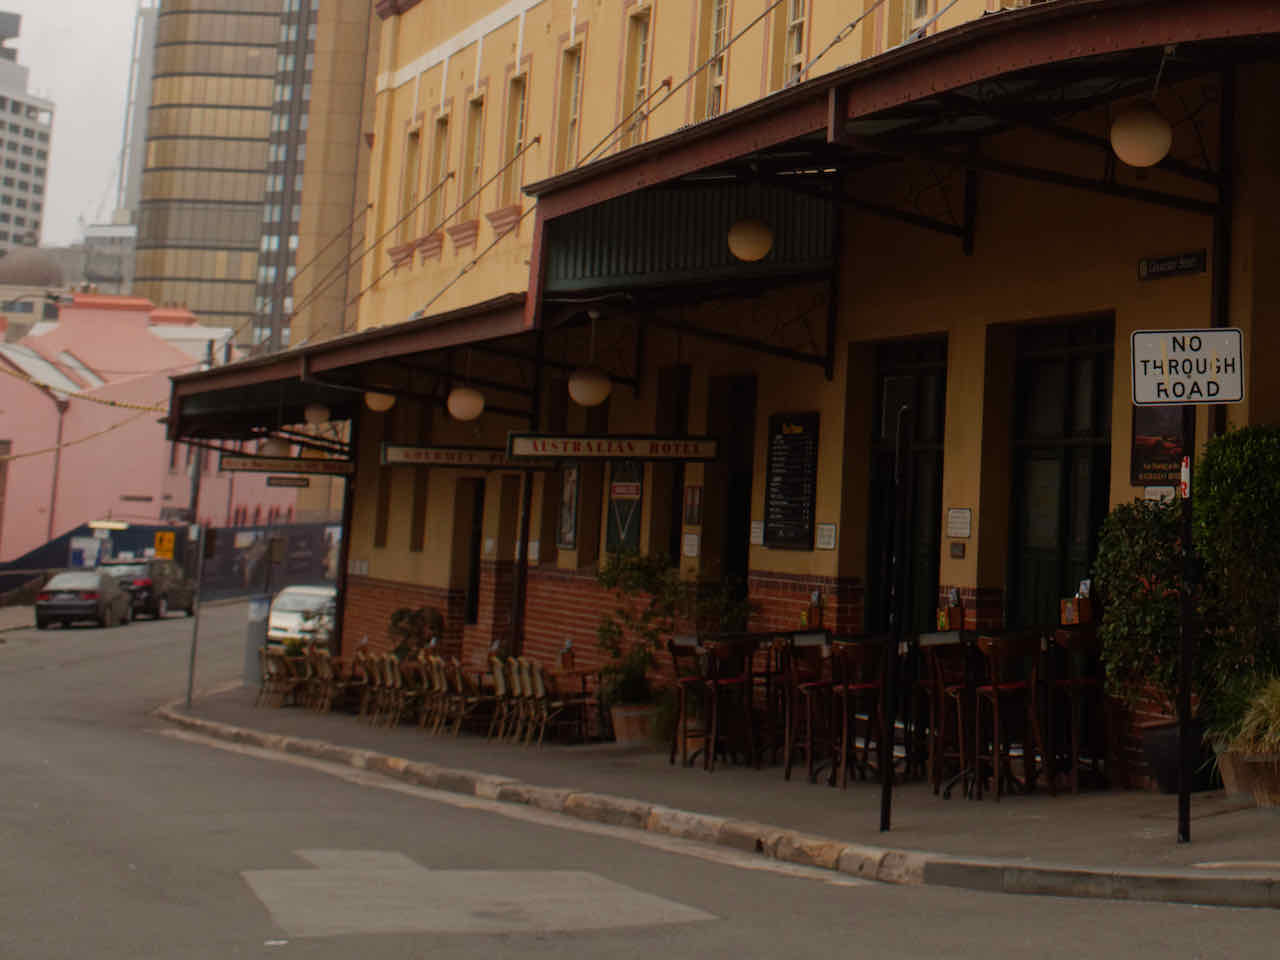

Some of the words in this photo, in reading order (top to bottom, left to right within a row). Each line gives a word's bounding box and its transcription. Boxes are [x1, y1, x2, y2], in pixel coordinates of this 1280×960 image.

[1171, 335, 1202, 352] NO
[1140, 357, 1235, 376] THROUGH
[1157, 381, 1220, 398] ROAD
[532, 440, 634, 454] AUSTRALIAN
[649, 442, 700, 455] HOTEL
